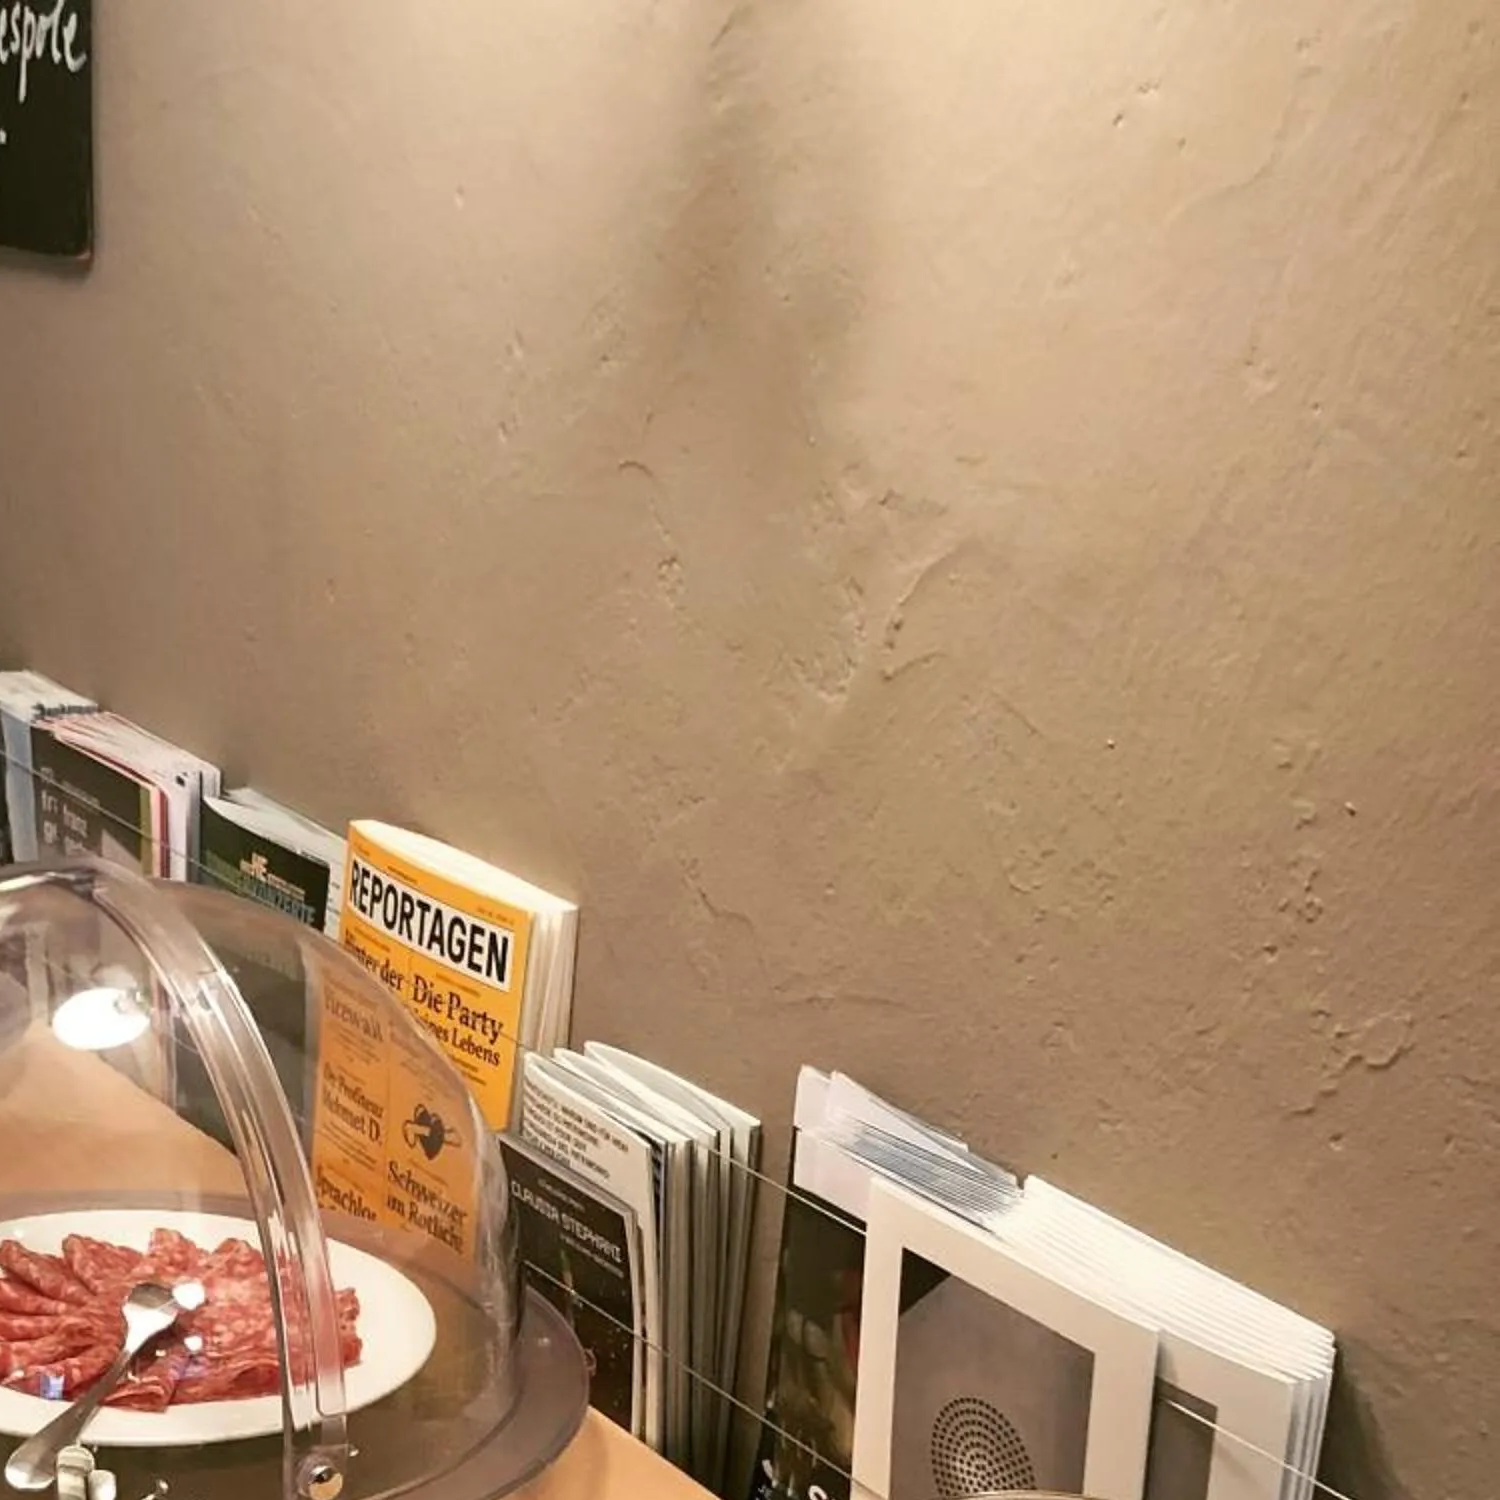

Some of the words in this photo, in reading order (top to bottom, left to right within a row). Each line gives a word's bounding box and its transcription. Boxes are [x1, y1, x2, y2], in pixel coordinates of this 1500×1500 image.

[350, 860, 509, 983] REPORTAGEN
[413, 972, 444, 1014] Die
[447, 991, 503, 1045] Party
[452, 1028, 501, 1067] Lebens
